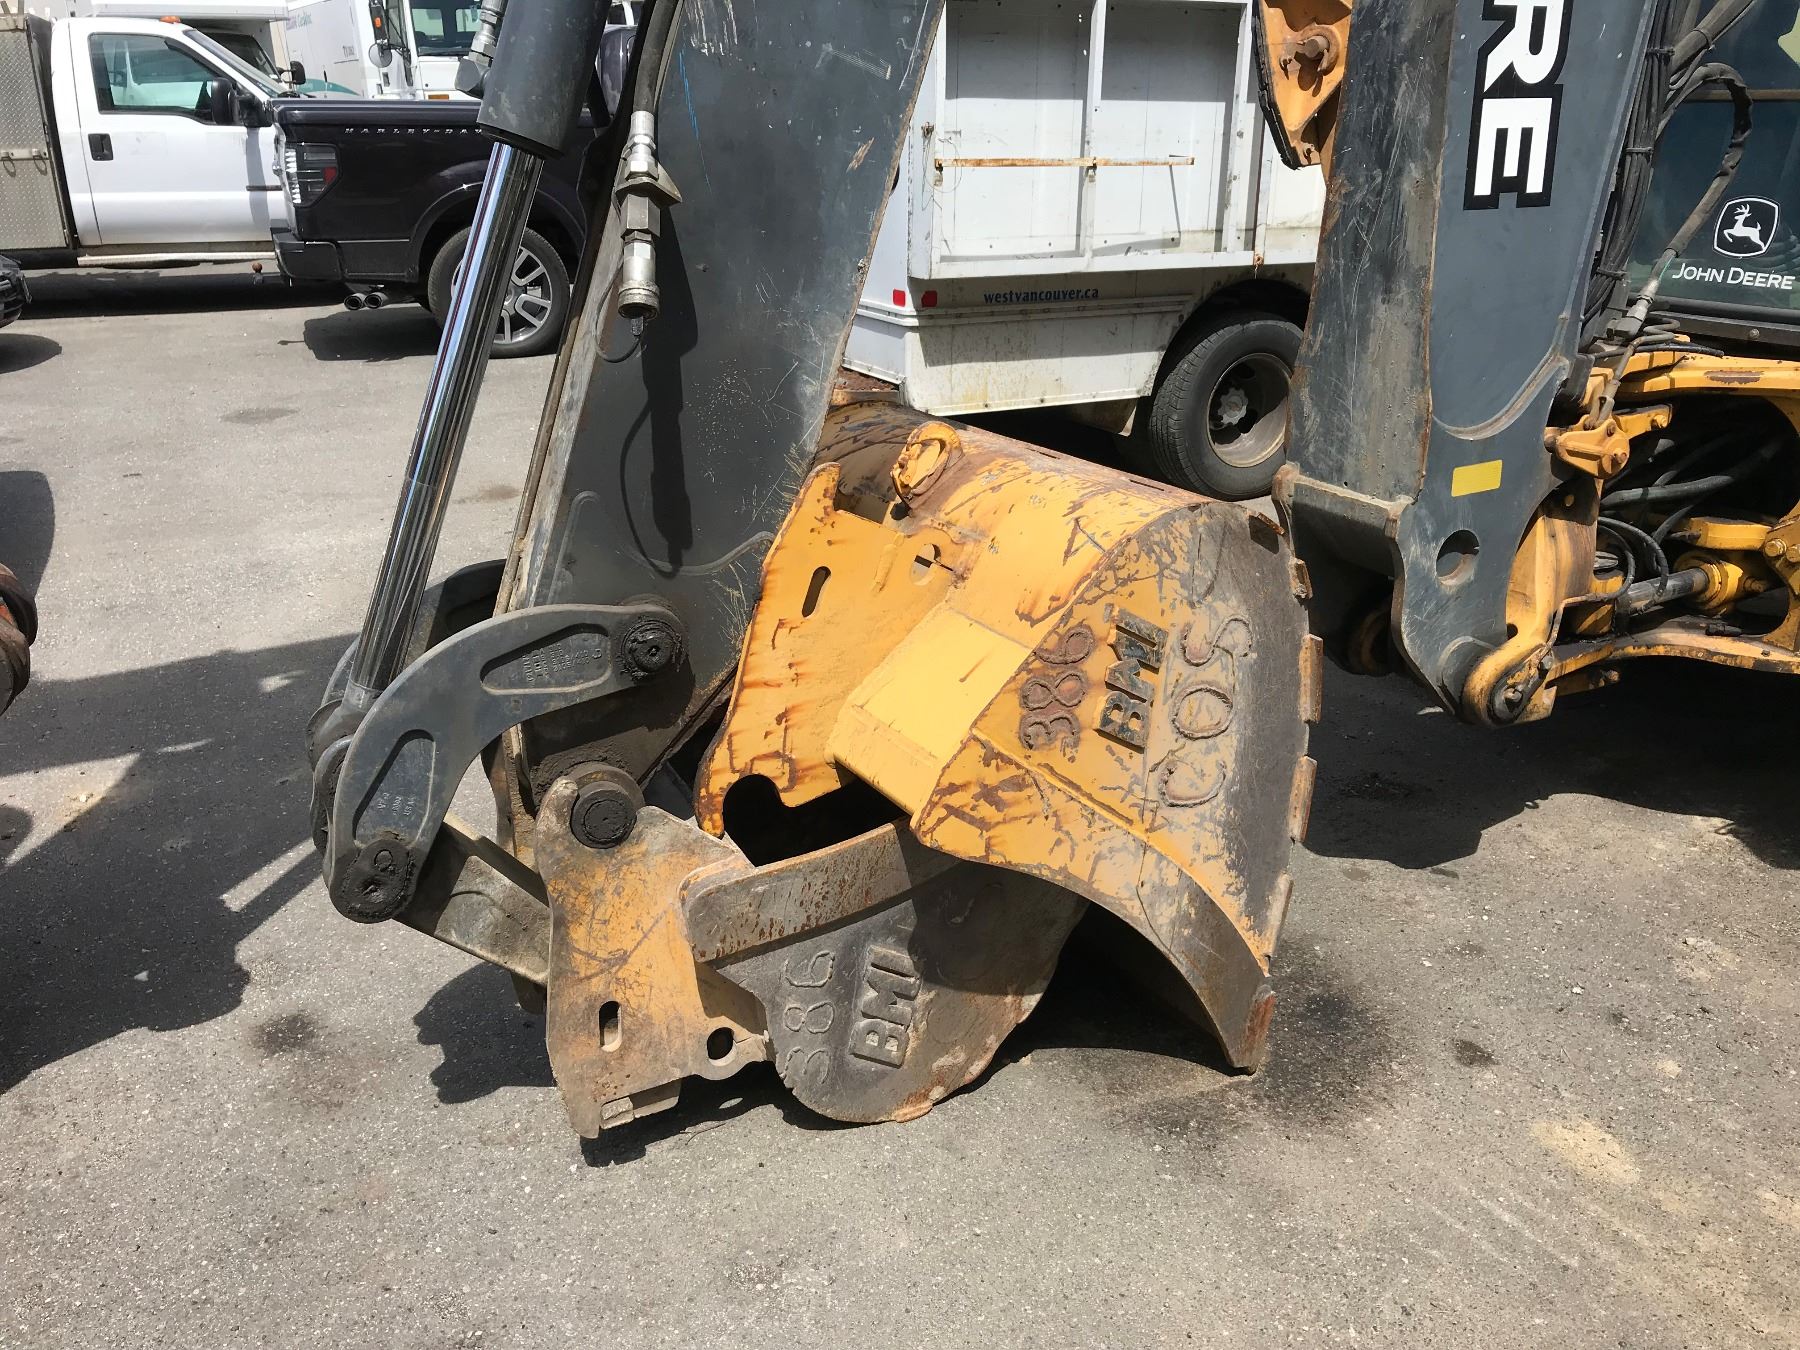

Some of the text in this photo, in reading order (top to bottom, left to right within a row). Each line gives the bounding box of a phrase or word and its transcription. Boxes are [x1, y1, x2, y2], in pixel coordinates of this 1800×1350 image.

[983, 287, 1100, 305] westvancouver.ca
[1671, 263, 1796, 290] JOHN DEERE
[1019, 624, 1095, 751] 386
[1095, 604, 1169, 754] BMI
[779, 950, 836, 1086] 386
[848, 945, 922, 1069] BMI
